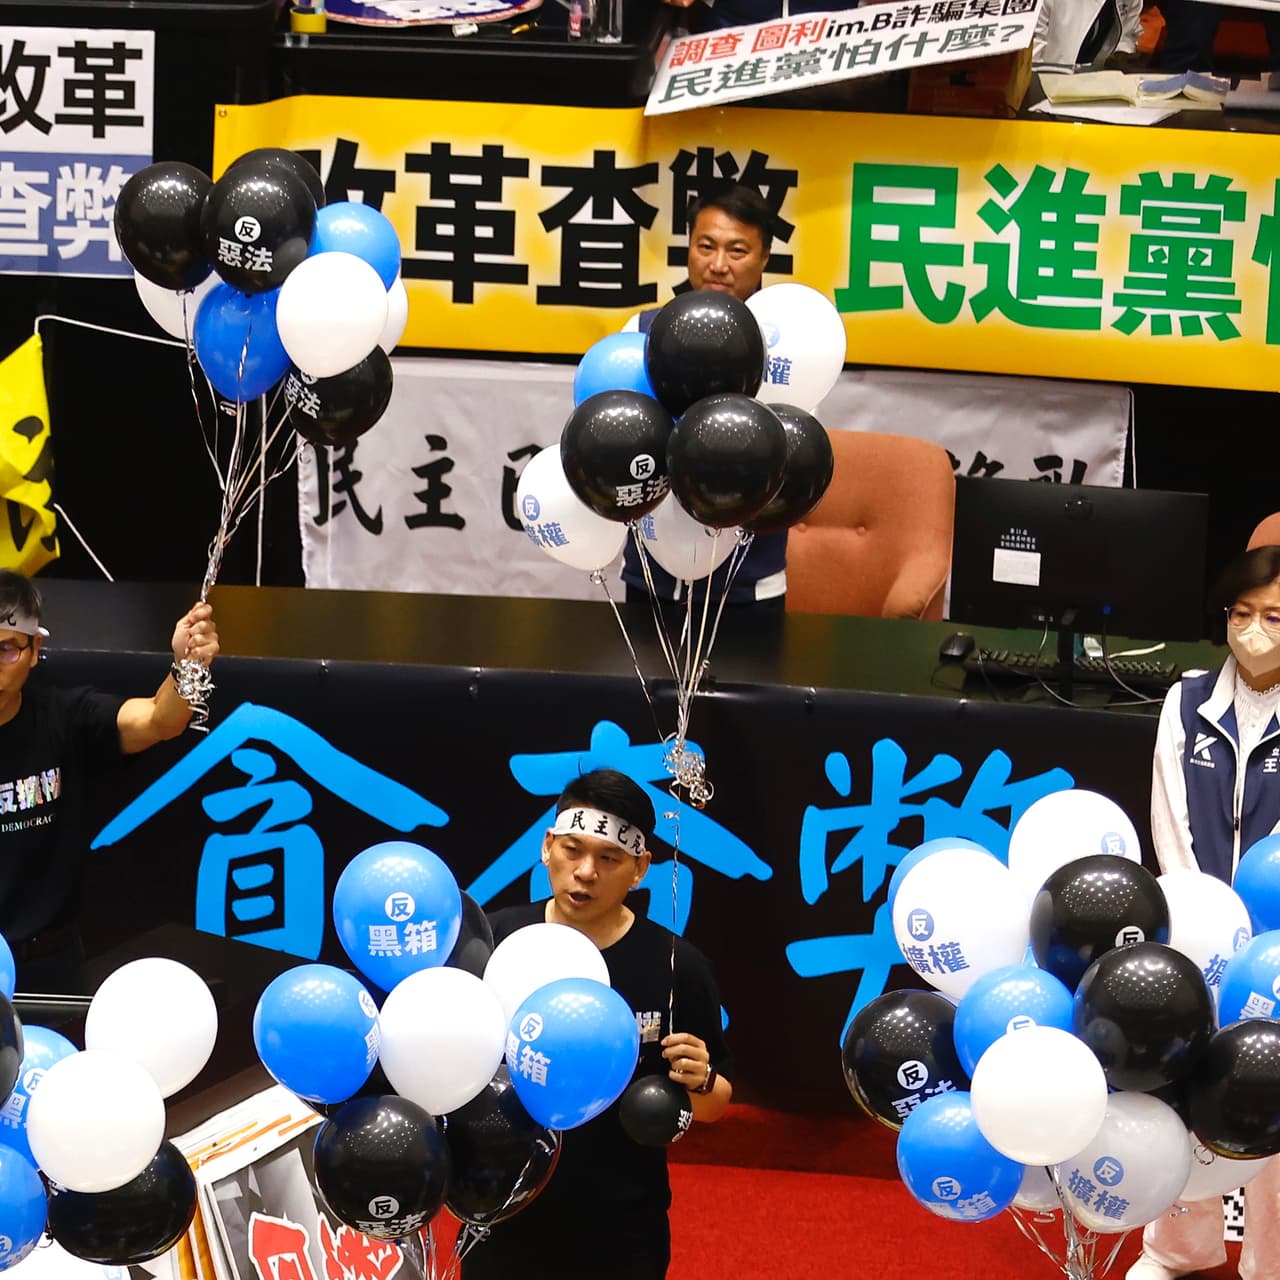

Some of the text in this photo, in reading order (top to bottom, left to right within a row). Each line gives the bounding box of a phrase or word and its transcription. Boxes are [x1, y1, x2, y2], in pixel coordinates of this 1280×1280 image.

[662, 22, 1025, 105] 民進黨怕什麼?
[671, 31, 746, 68] 調查
[216, 238, 274, 274] 惡法
[835, 162, 1280, 346] 民進黨
[614, 477, 669, 507] 惡法
[570, 809, 644, 855] 民主已死
[367, 920, 438, 958] 黑箱
[900, 940, 970, 974] 擴權
[1066, 1166, 1129, 1220] 擴權
